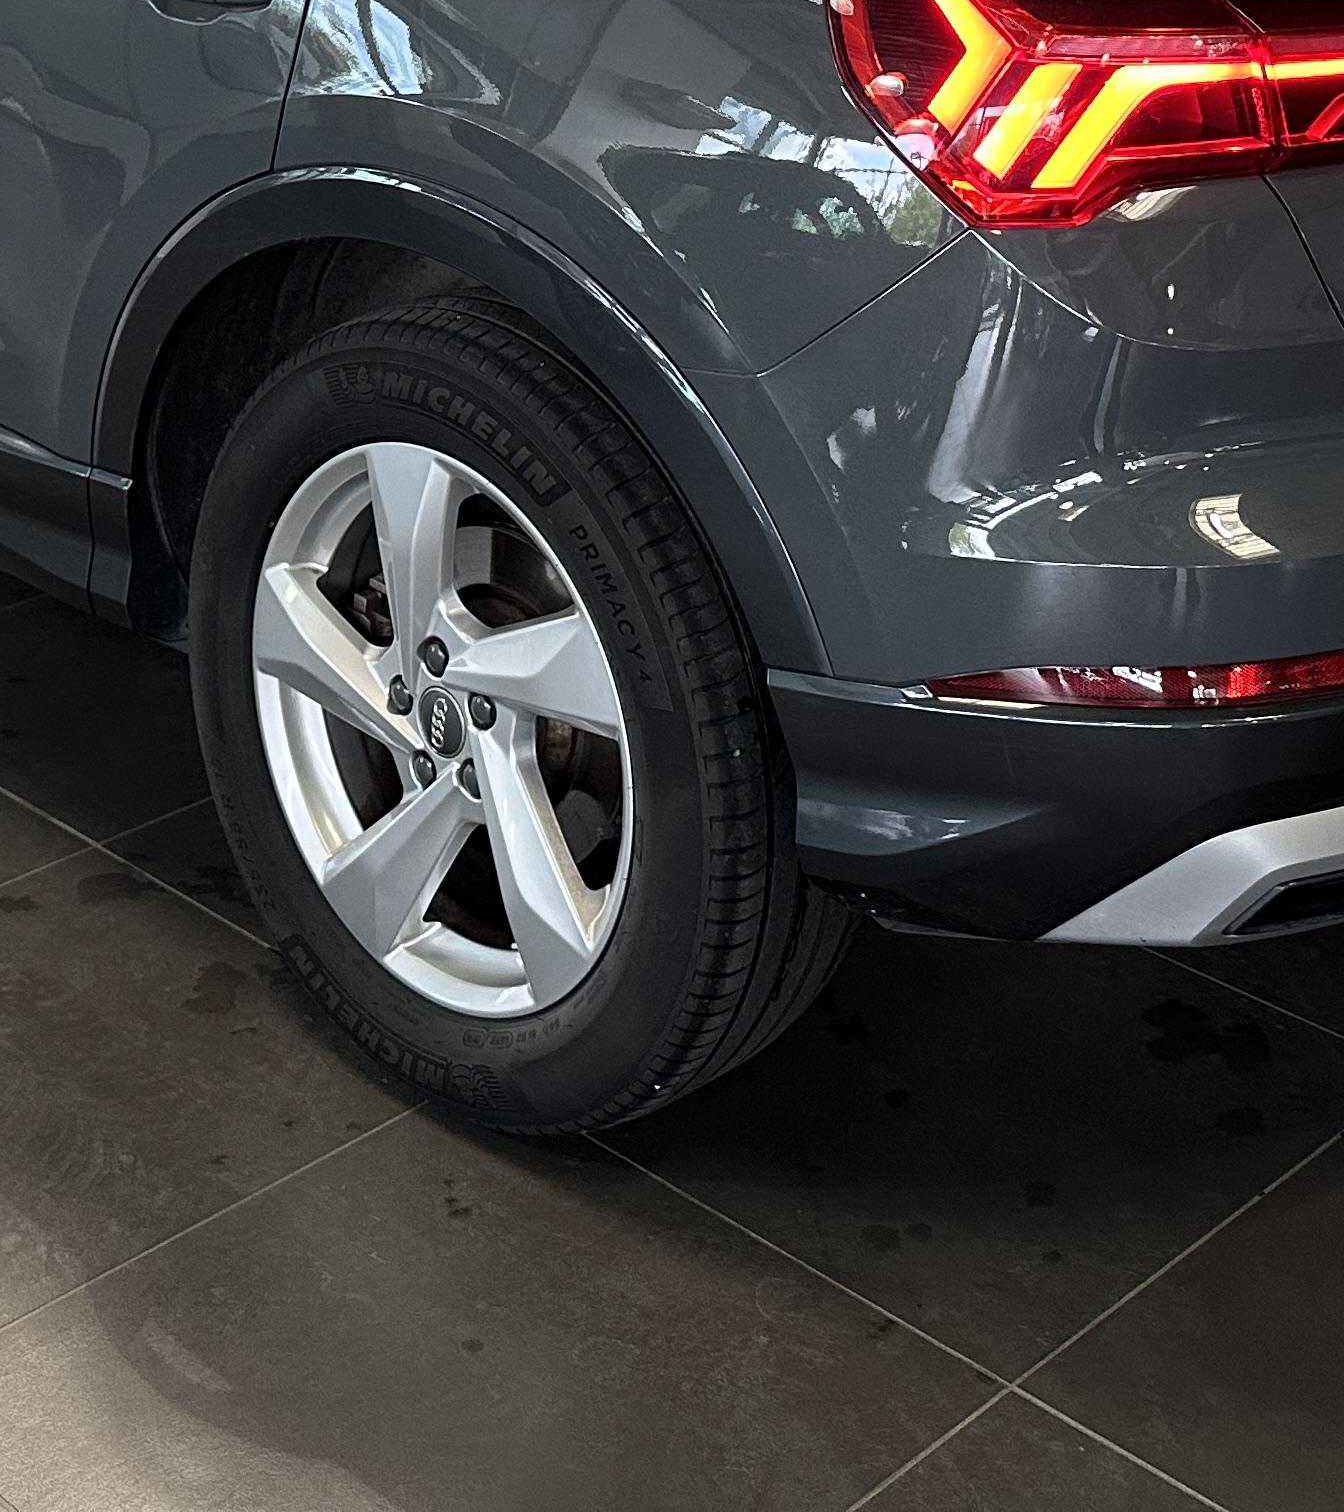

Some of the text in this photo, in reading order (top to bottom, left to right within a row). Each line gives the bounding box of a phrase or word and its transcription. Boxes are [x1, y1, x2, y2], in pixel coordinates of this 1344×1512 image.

[381, 370, 557, 497] MICHELIN
[568, 524, 648, 665] PRIMACY
[289, 943, 447, 1084] MICHELIN
